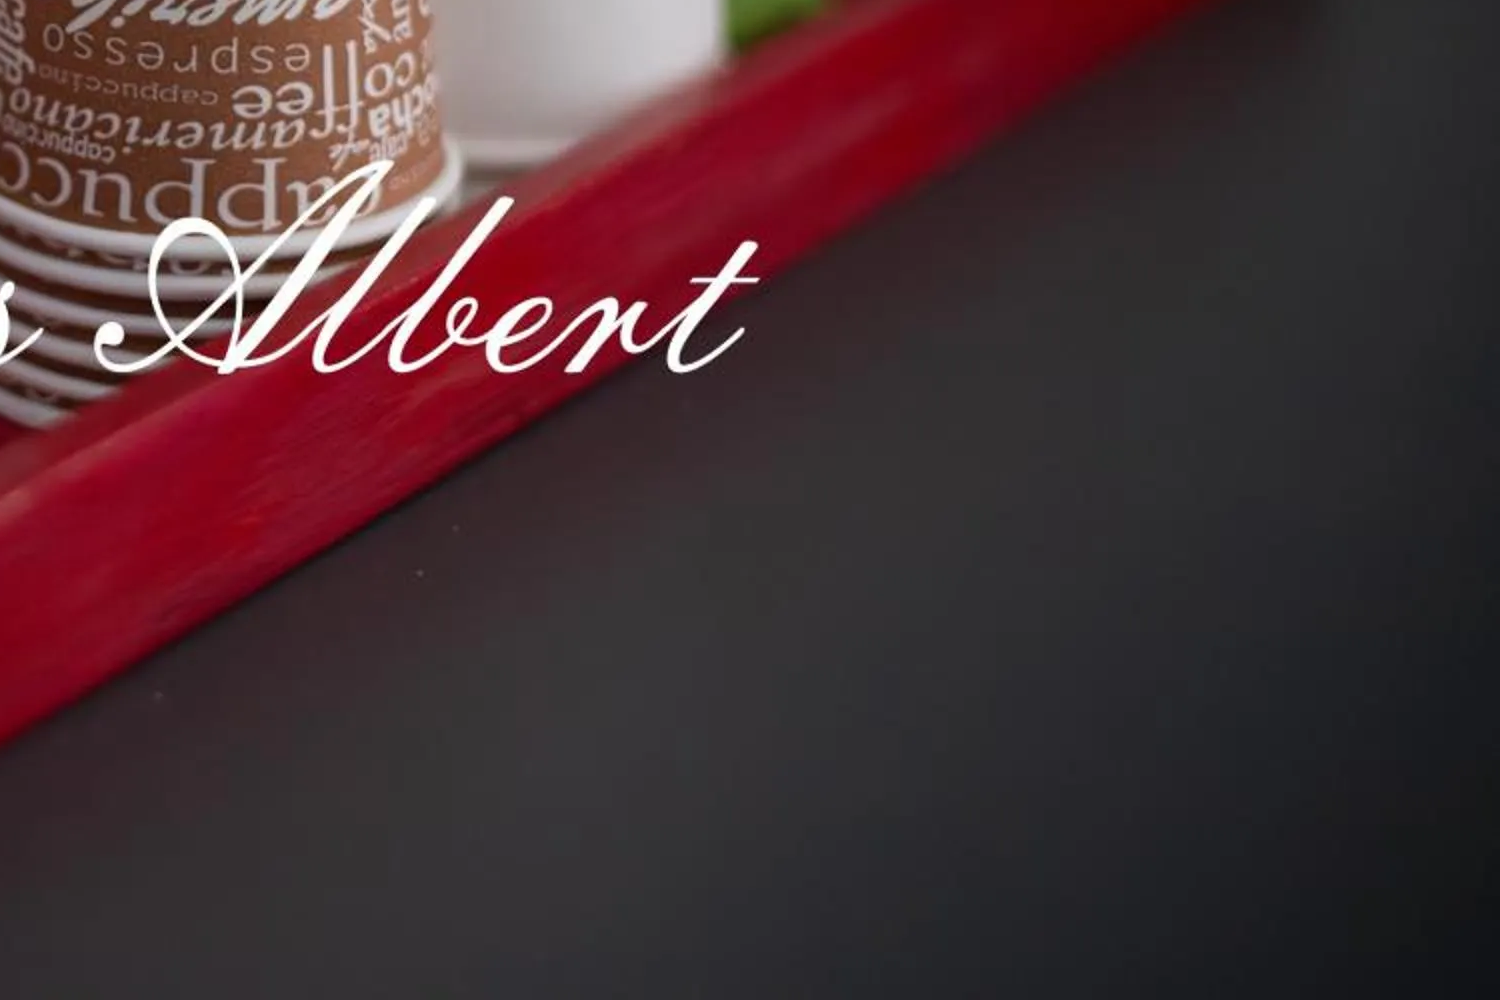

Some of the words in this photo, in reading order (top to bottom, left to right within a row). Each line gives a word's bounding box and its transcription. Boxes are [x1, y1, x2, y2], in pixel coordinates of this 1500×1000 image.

[42, 22, 312, 75] espresso
[37, 62, 218, 108] cappuccino
[231, 40, 417, 147] coffee
[9, 87, 308, 155] americano
